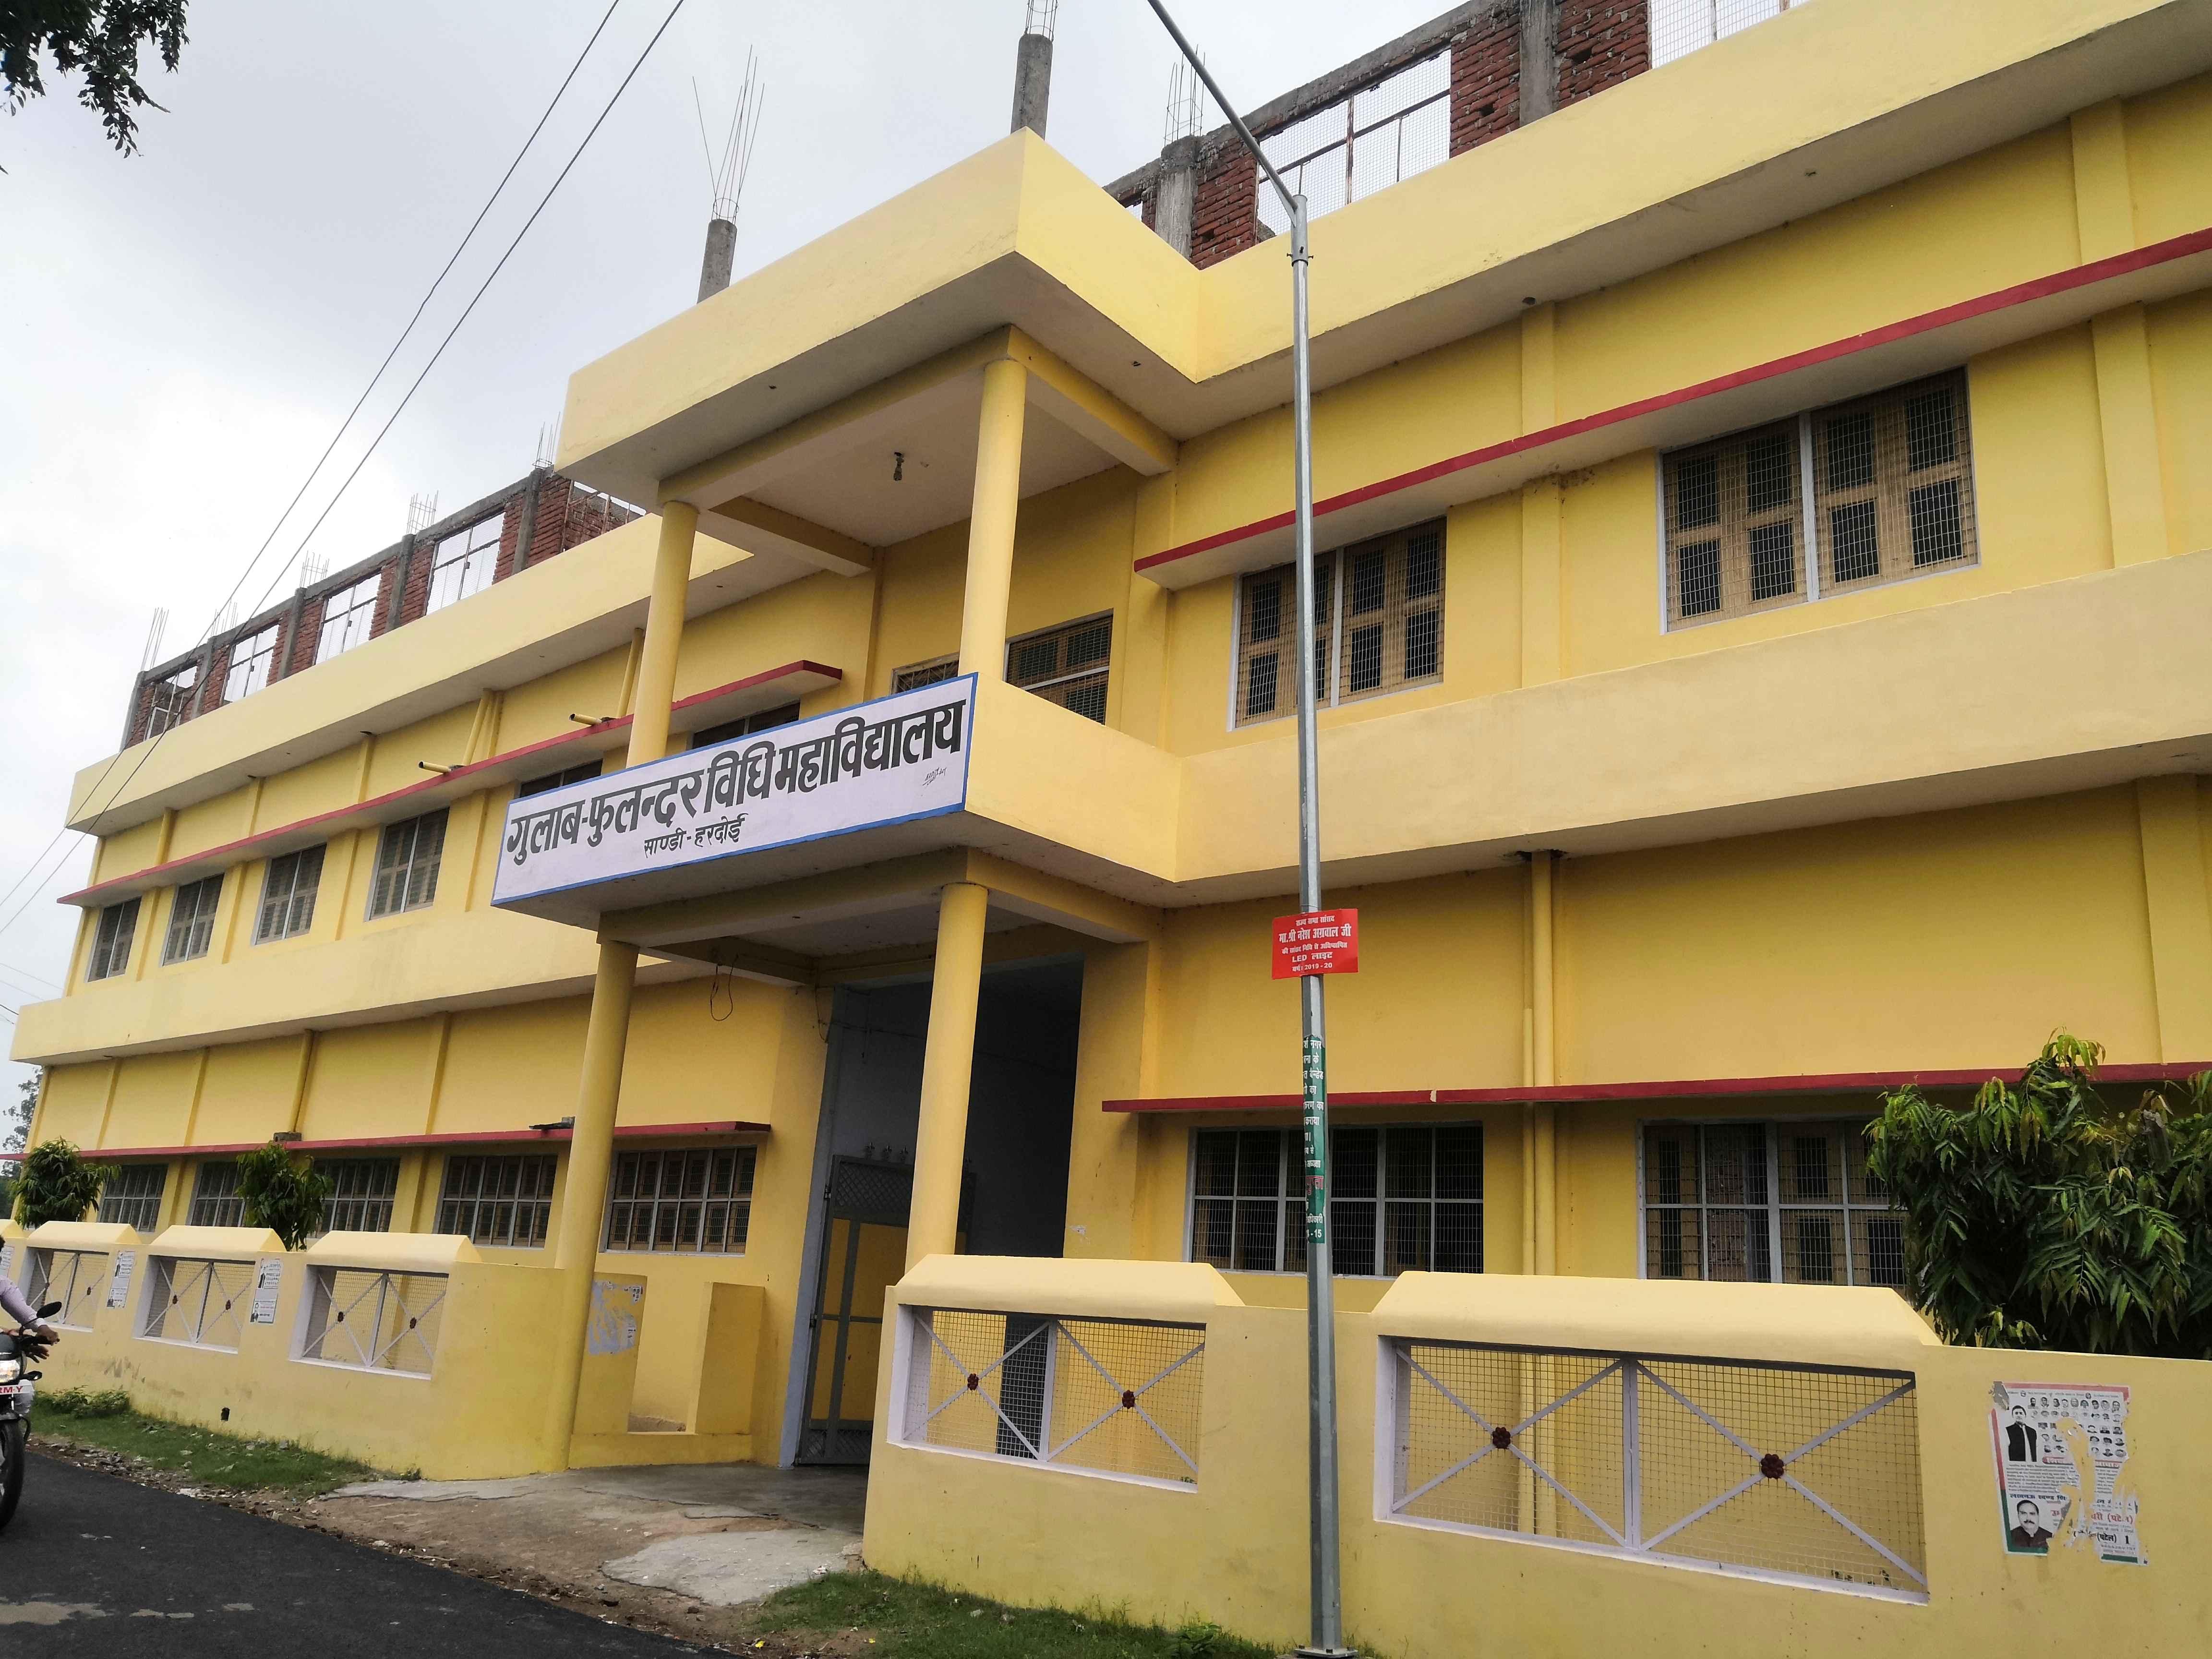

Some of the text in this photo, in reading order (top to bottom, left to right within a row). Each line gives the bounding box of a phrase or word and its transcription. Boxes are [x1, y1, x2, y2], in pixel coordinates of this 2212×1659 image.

[704, 741, 775, 813] विधि
[774, 699, 966, 794] महाविद्यालय
[1298, 928, 1310, 940] नरेश
[1313, 926, 1338, 938] अग्रवाल
[1341, 923, 1351, 937] जी
[1310, 1040, 1322, 1049] नगर
[1313, 1052, 1319, 1064] के
[1317, 1101, 1323, 1110] का
